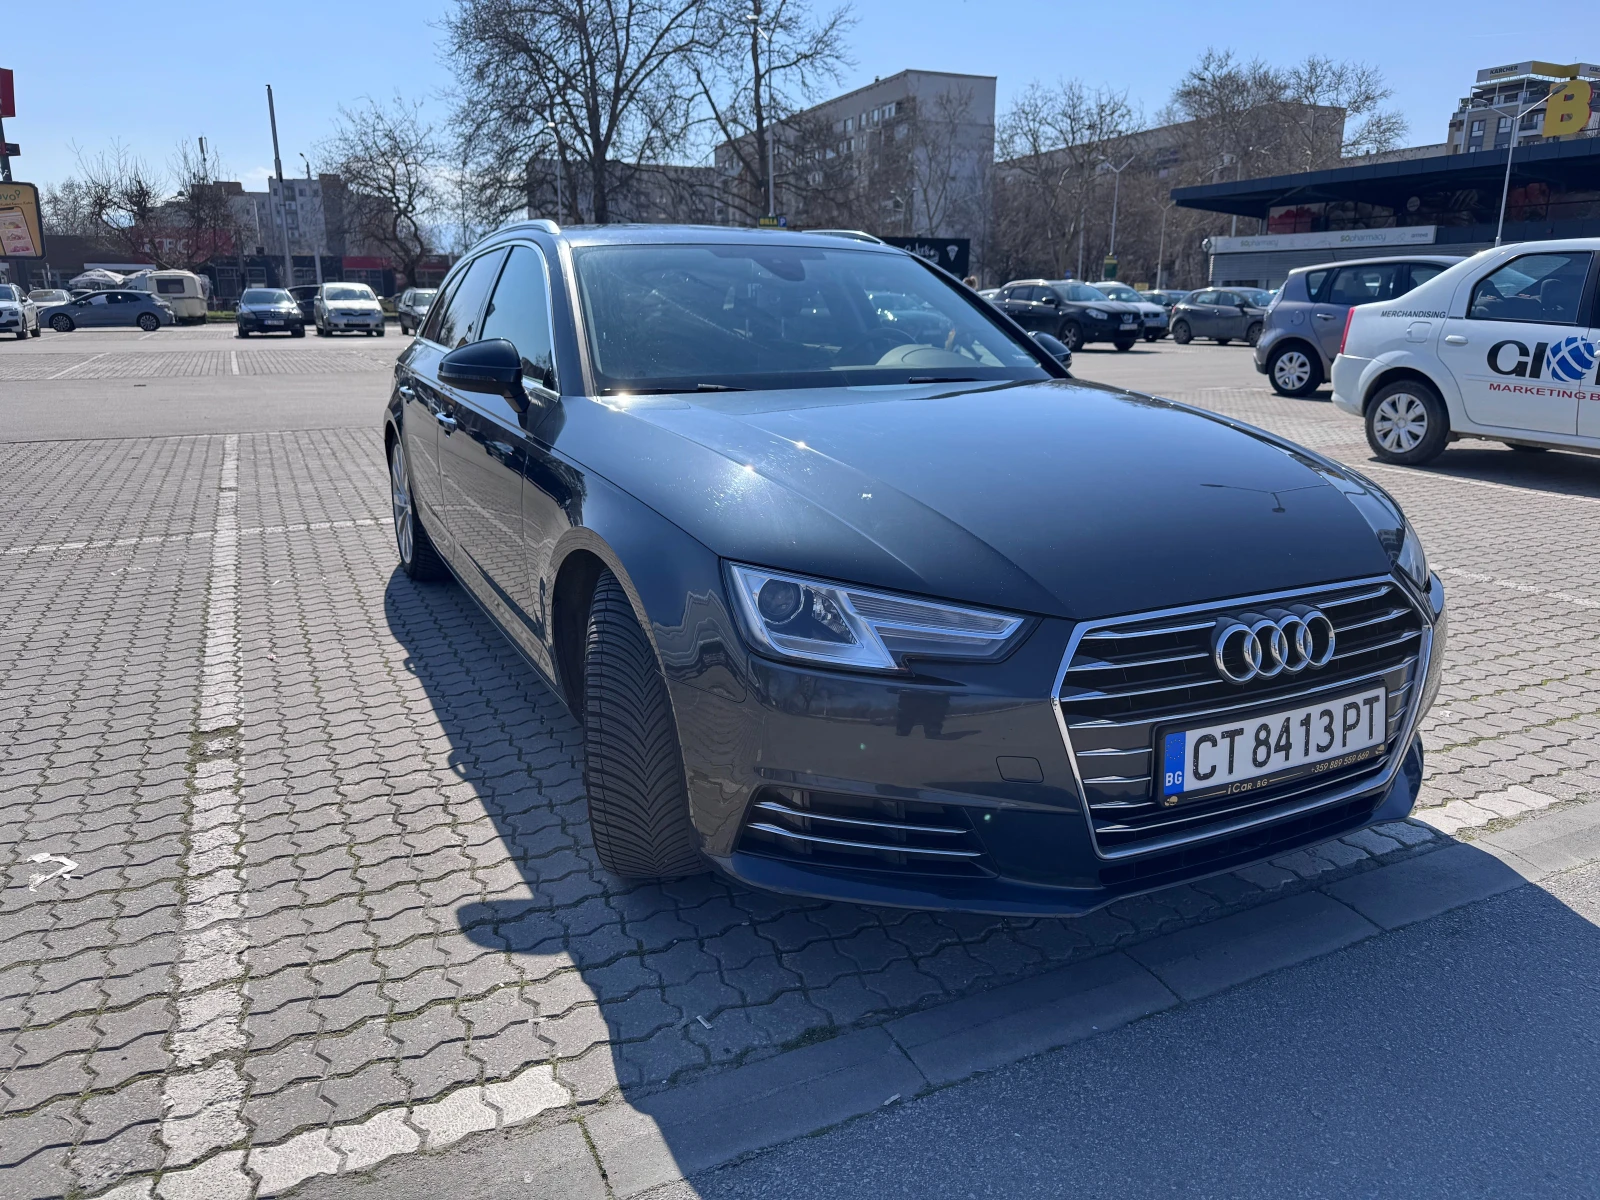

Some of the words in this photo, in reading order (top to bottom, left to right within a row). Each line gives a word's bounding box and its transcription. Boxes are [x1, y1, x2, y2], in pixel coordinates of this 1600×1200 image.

[1542, 80, 1593, 138] B
[1380, 310, 1446, 319] MERCHANDISING
[1489, 383, 1586, 400] MARKETING
[1193, 727, 1245, 781] CT
[1251, 708, 1335, 768] 8413
[1341, 694, 1381, 748] PT
[1165, 771, 1183, 787] BG
